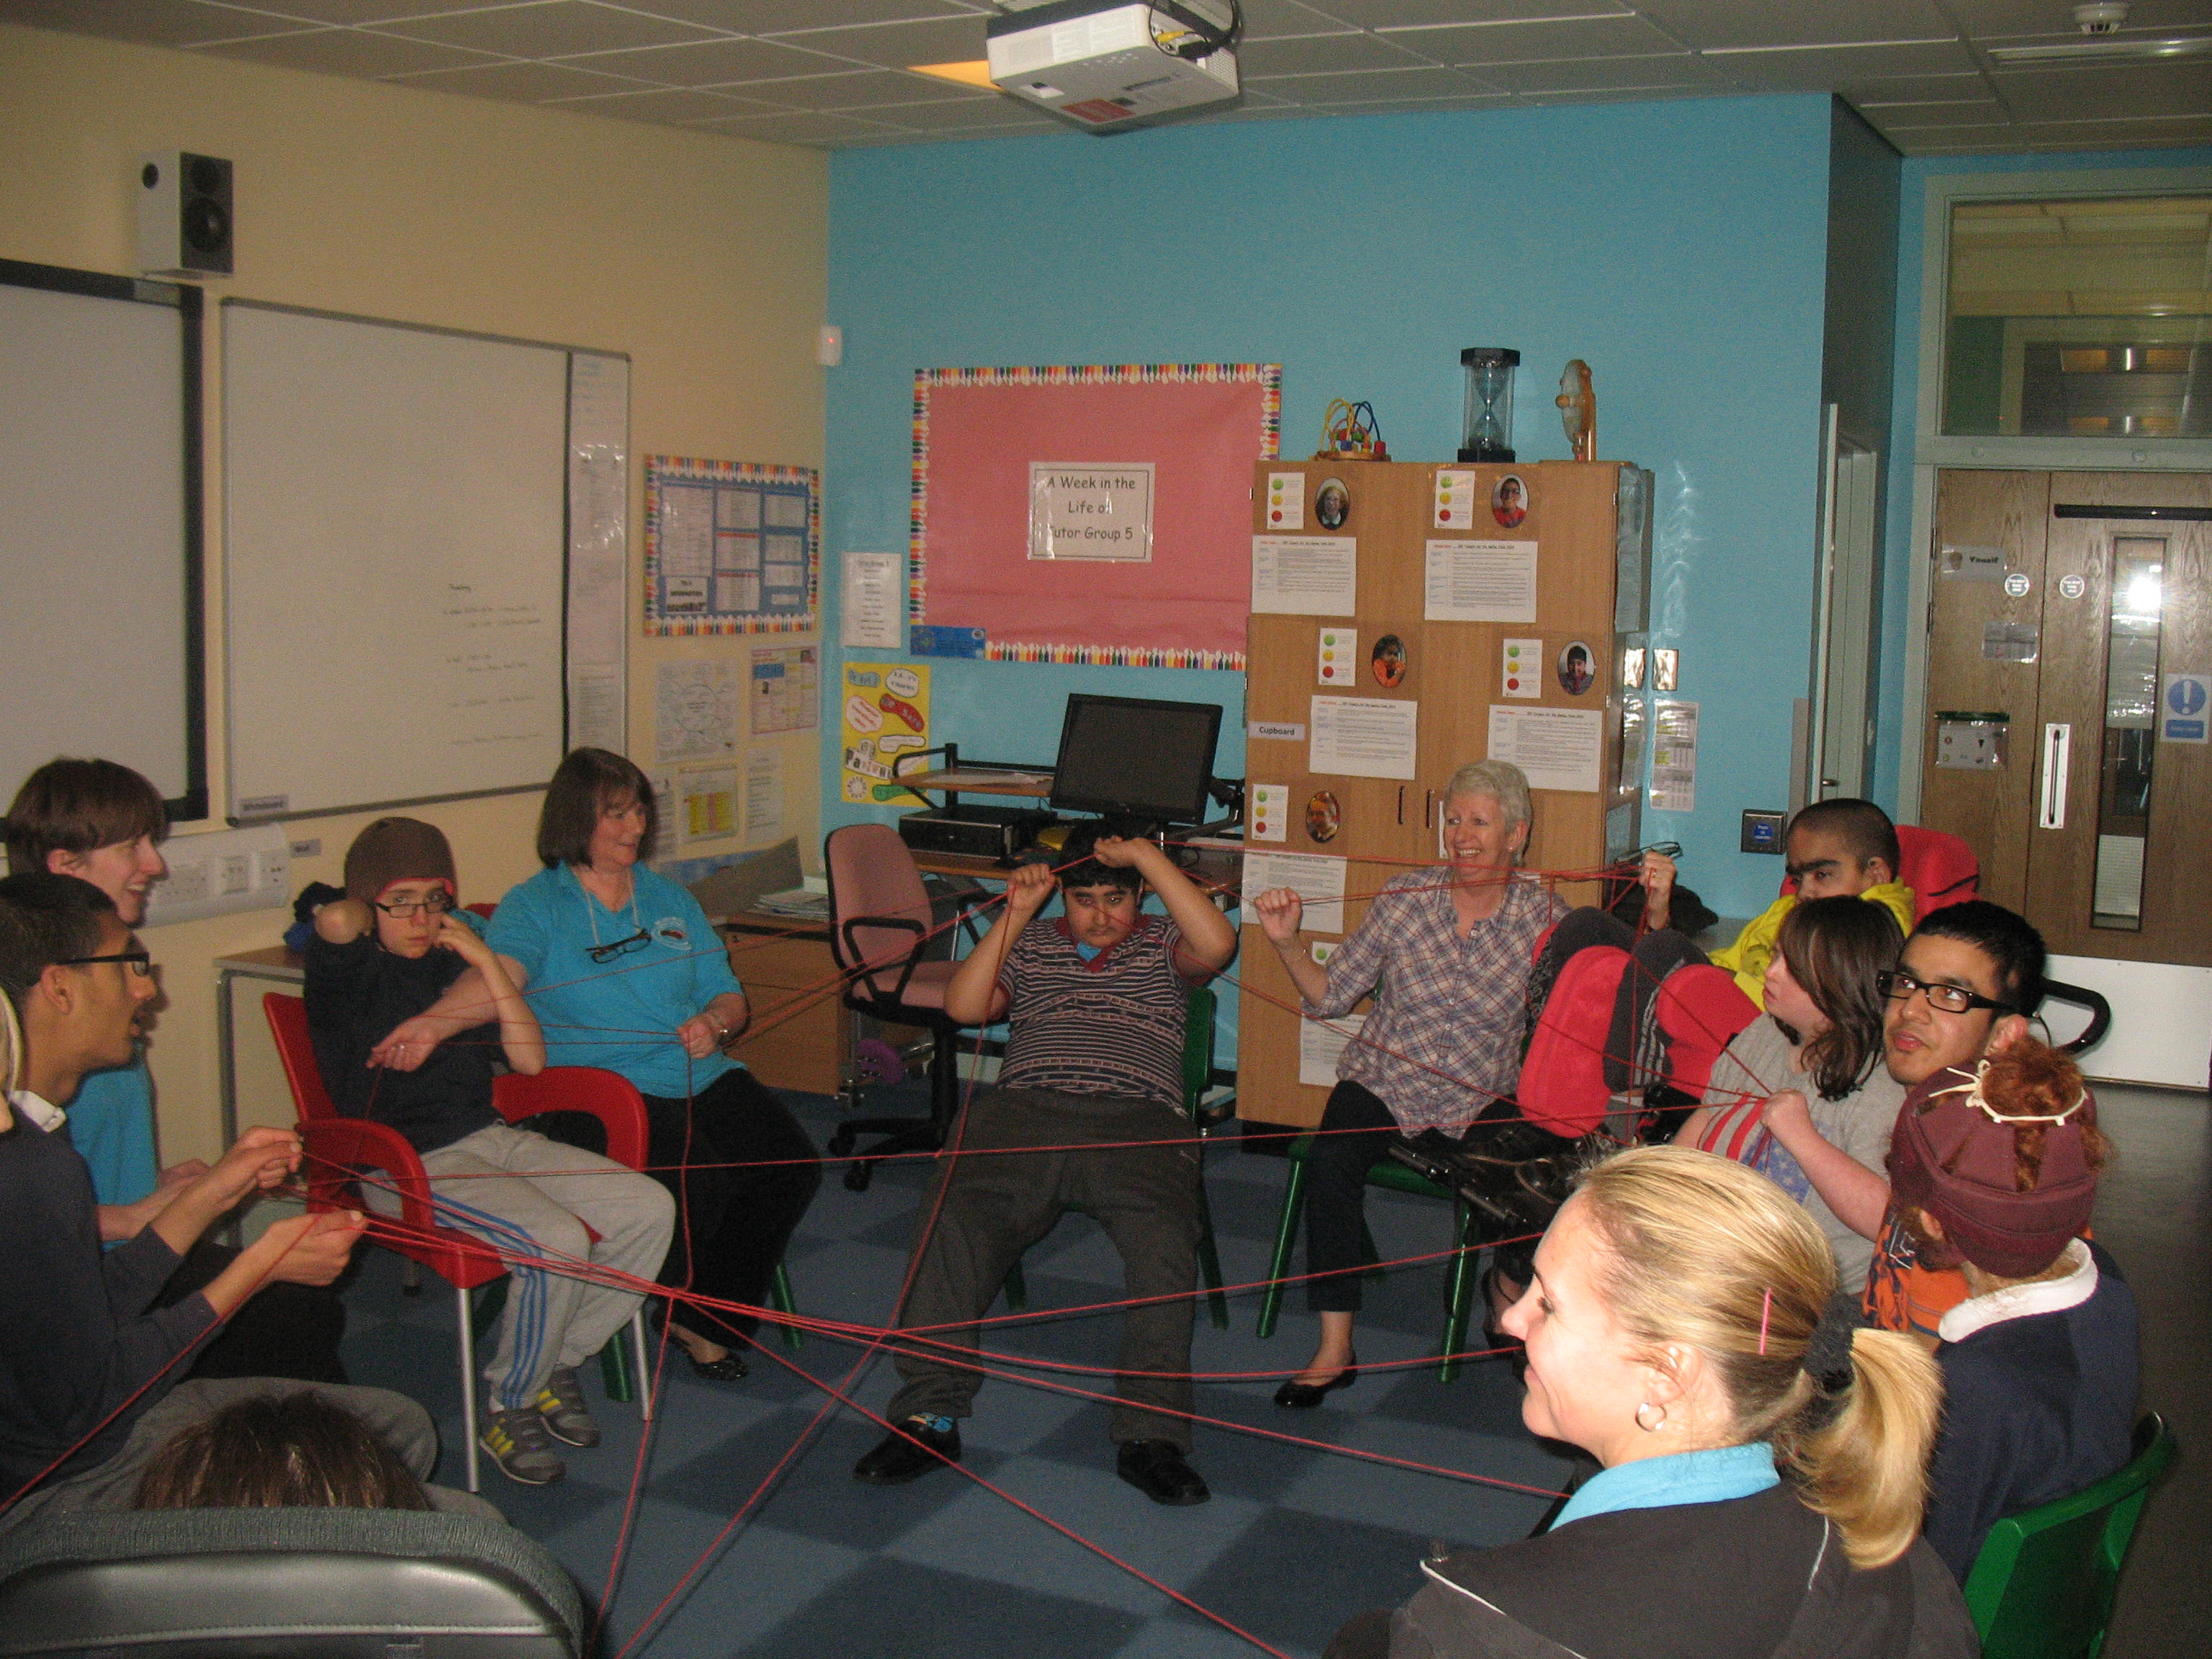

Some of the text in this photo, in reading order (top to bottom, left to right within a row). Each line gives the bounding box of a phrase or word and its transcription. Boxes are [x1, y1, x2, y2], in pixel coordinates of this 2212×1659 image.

[1048, 476, 1136, 490] A Week in the
[1069, 500, 1094, 514] Life
[1084, 526, 1121, 542] Group
[1125, 527, 1133, 540] 5
[1259, 727, 1295, 736] Cupboard
